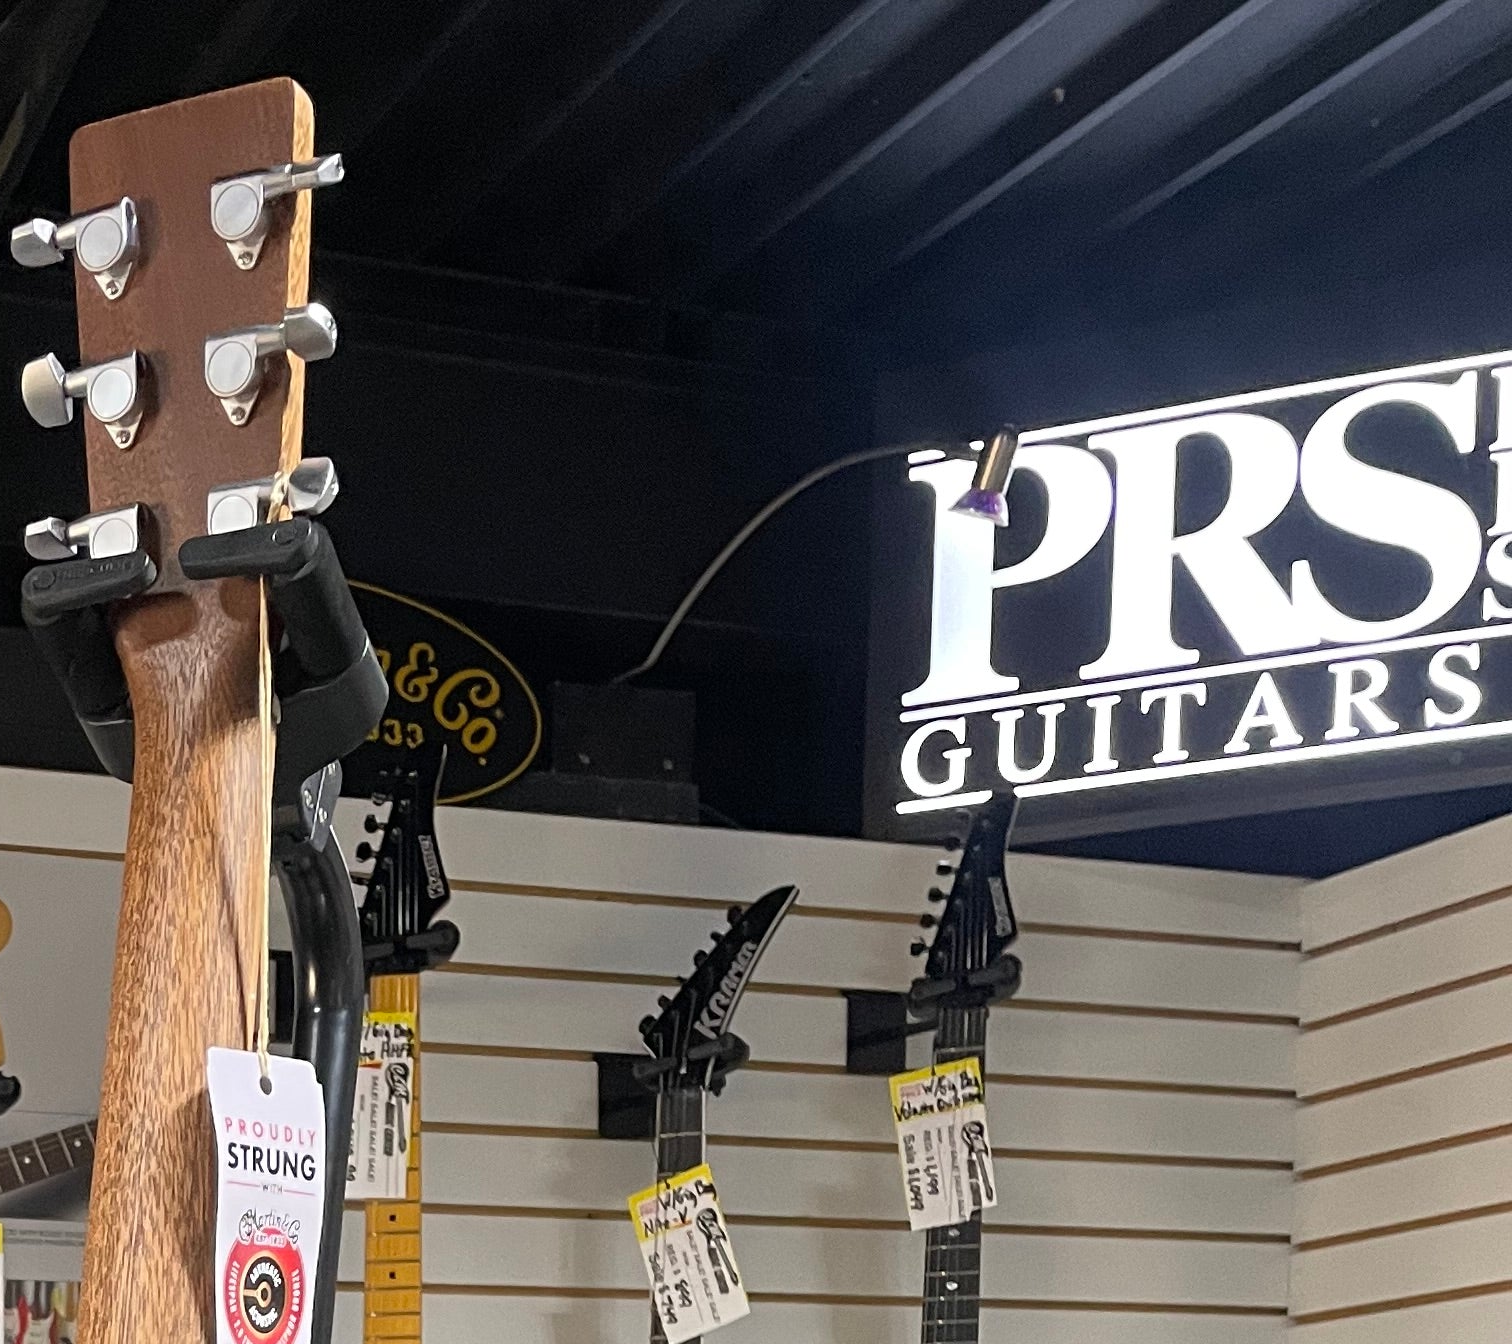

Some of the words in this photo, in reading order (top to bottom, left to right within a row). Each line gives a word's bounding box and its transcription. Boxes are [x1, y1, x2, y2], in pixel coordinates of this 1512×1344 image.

[901, 371, 1482, 707] PRS
[394, 642, 438, 702] &
[900, 642, 1483, 799] GUITARS
[225, 1117, 316, 1147] PROUDLY
[228, 1142, 316, 1181] STRUNG
[261, 1183, 283, 1194] WITH
